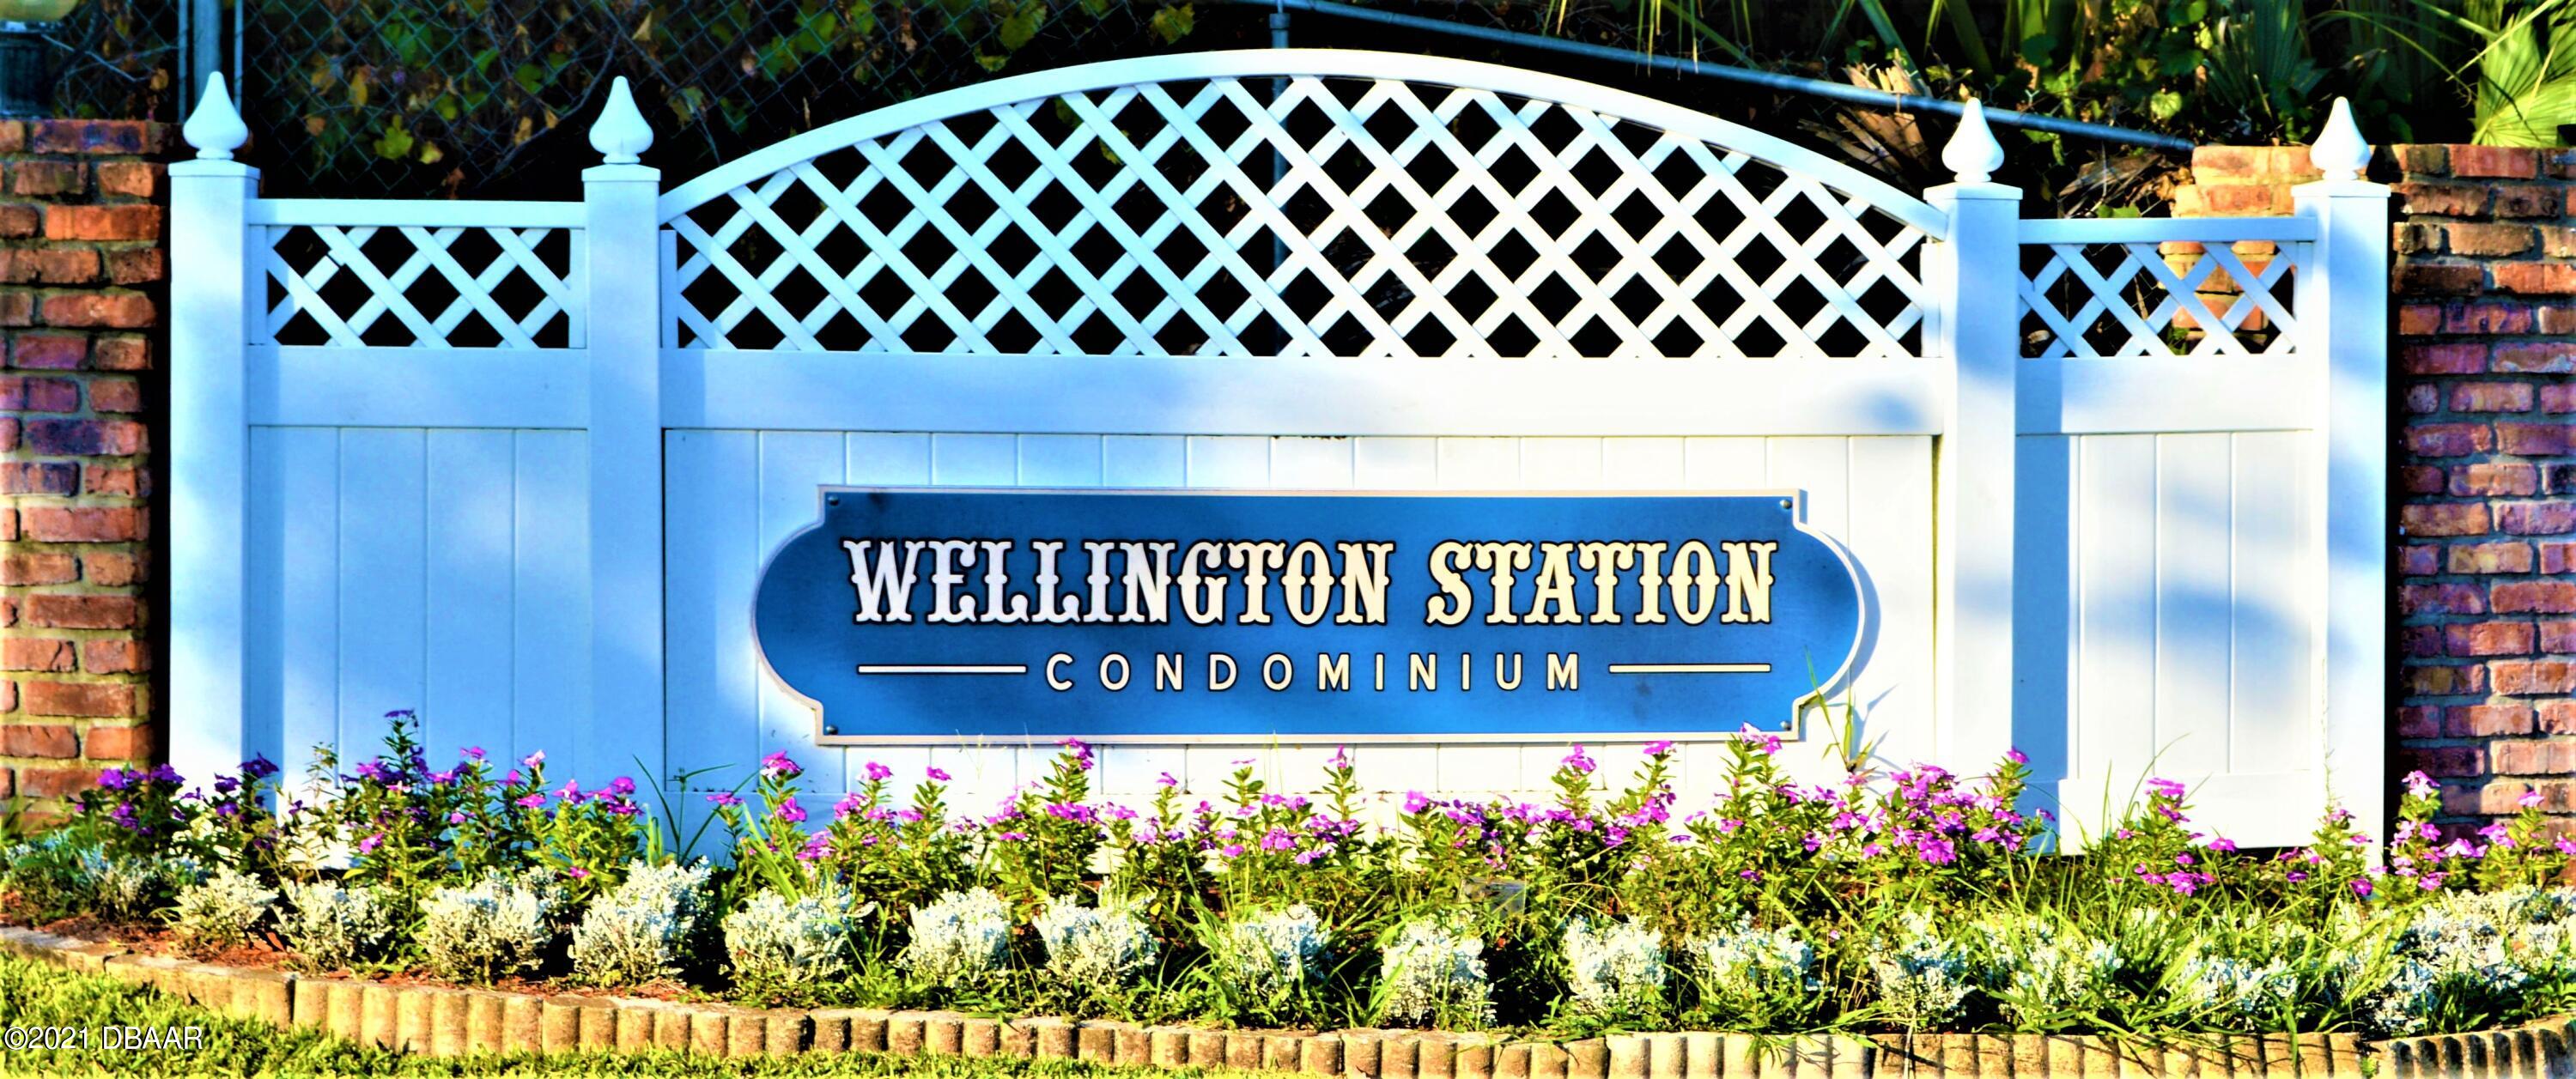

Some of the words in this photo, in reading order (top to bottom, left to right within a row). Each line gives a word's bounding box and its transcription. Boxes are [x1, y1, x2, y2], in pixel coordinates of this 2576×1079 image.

[842, 538, 1395, 627] WELLINGTON
[1425, 539, 1778, 626] STATION
[1045, 652, 1581, 692] CONDOMINIUM
